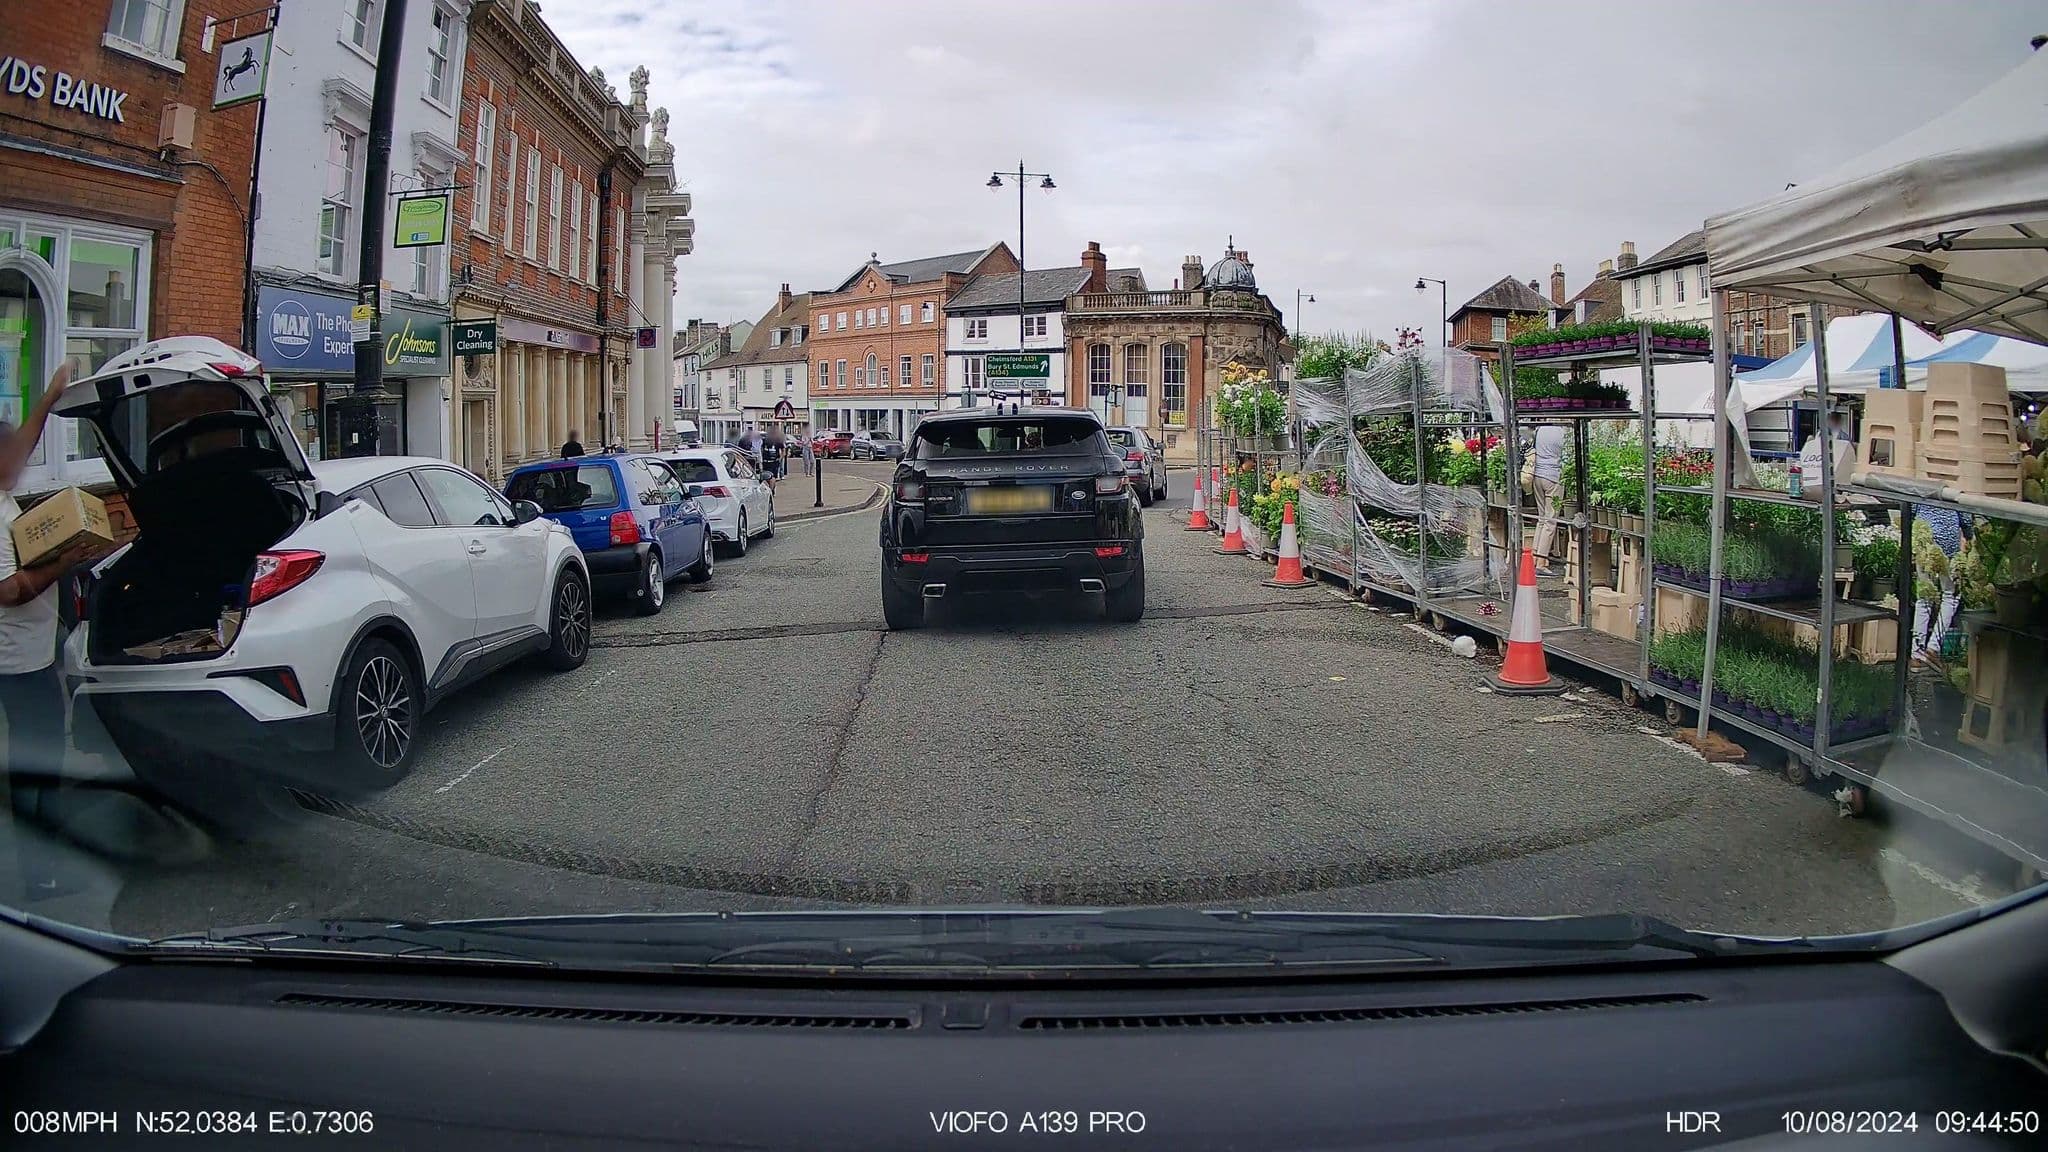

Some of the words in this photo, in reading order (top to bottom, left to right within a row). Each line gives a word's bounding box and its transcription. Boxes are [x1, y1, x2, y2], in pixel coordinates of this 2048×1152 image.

[53, 71, 128, 123] BANK
[273, 313, 310, 337] MAX
[316, 312, 334, 331] The
[385, 318, 436, 365] Johnsons
[467, 329, 483, 339] Dry
[324, 336, 355, 358] Expert
[456, 339, 493, 351] Cleaning
[987, 363, 1002, 371] Bury
